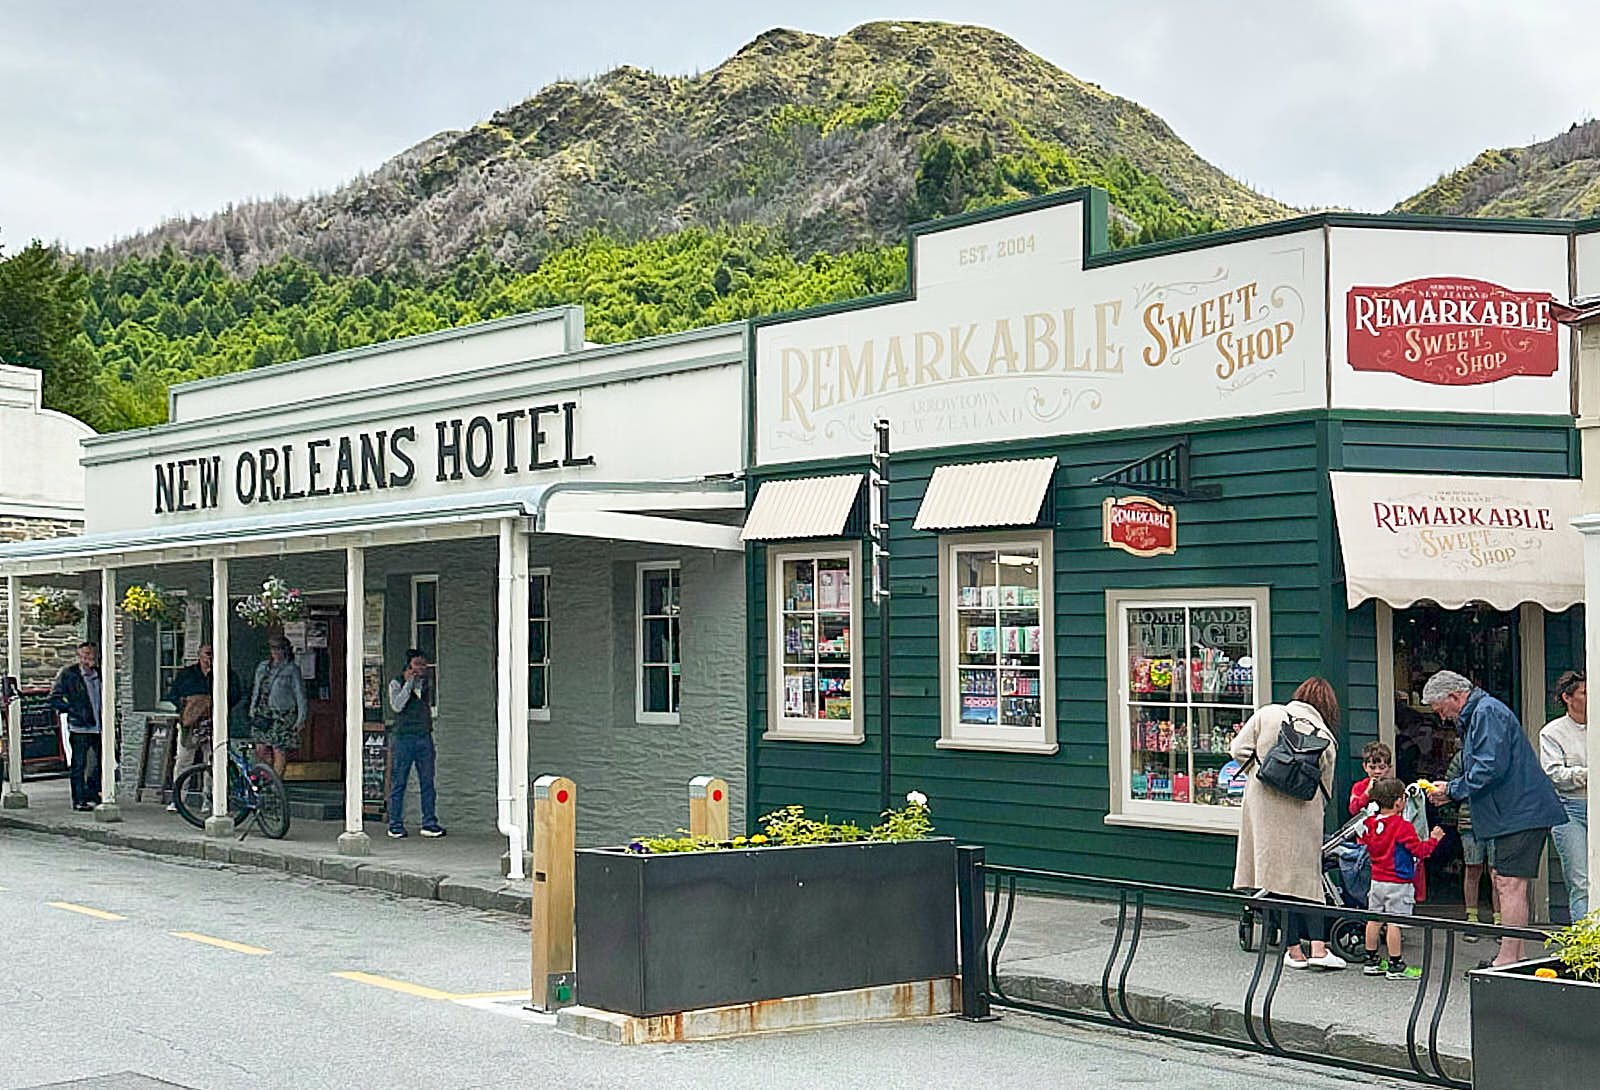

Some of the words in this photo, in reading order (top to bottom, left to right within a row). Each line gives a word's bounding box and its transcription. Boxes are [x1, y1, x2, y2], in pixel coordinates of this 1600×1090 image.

[960, 244, 991, 266] EST.
[998, 233, 1036, 257] 2004
[1143, 282, 1257, 367] SWEET
[1354, 296, 1552, 336] REMARKABLE
[1216, 321, 1294, 379] SHOP
[1405, 328, 1483, 361] SWEET
[779, 300, 1125, 432] REMARKABLE
[1456, 351, 1507, 376] SHOP
[155, 455, 221, 514] NEW
[236, 426, 415, 504] ORLEANS
[436, 402, 595, 482] HOTEL
[1111, 507, 1170, 529] REMARKABLE
[1373, 502, 1554, 533] REMARKABLE
[1420, 529, 1493, 557] SWEET
[1471, 547, 1517, 568] SHOP
[1192, 609, 1249, 623] MADE
